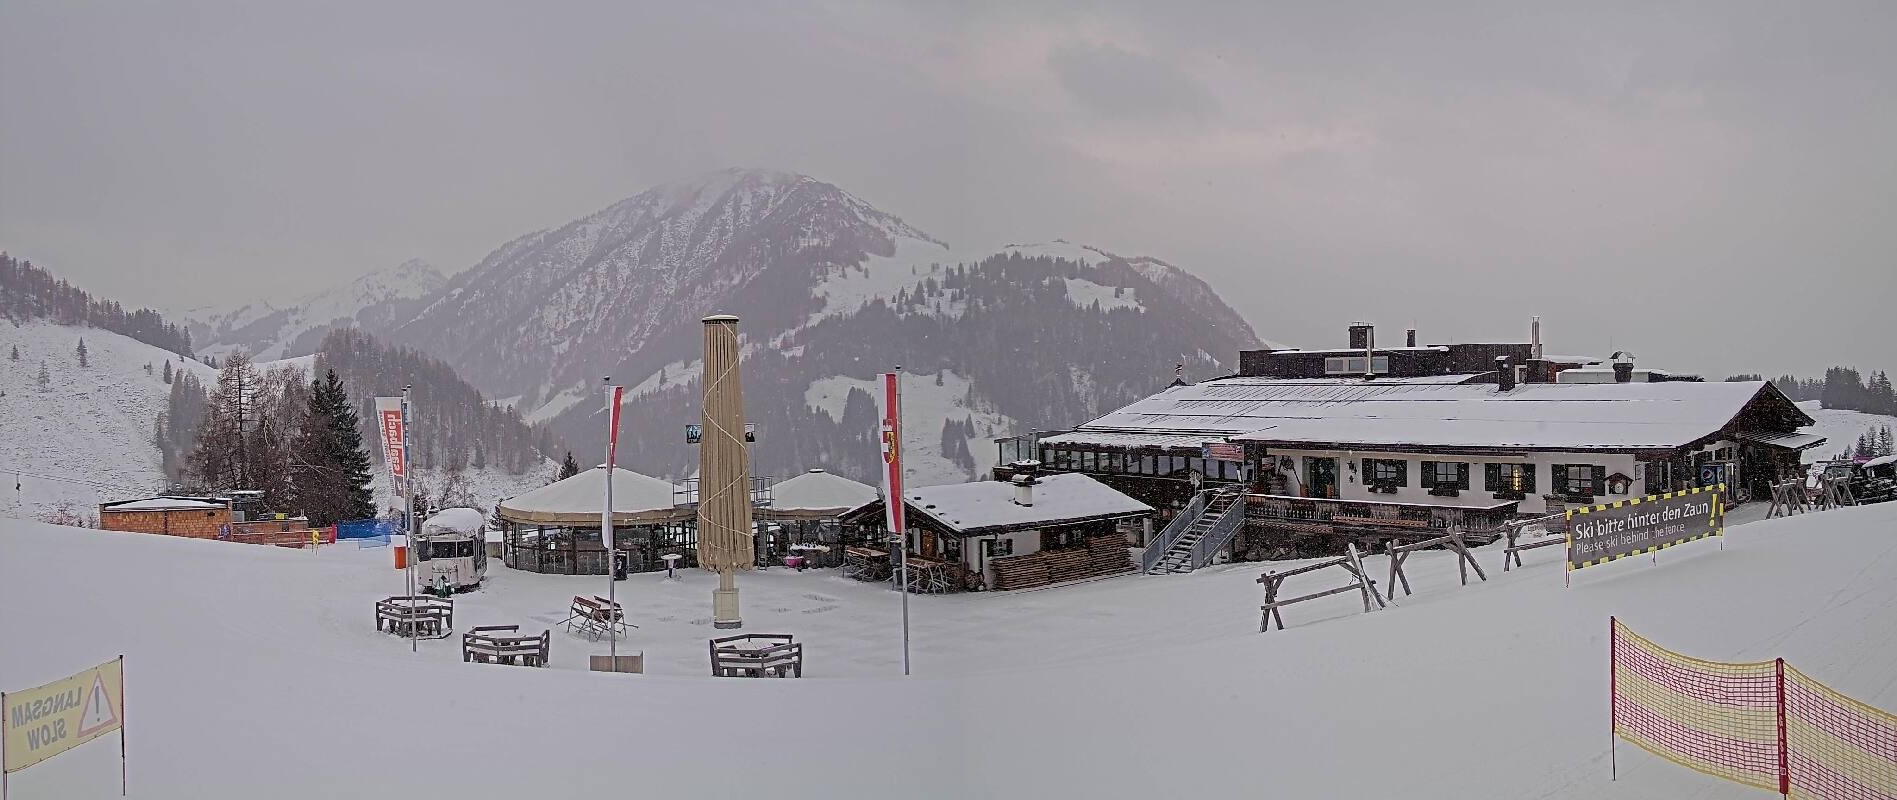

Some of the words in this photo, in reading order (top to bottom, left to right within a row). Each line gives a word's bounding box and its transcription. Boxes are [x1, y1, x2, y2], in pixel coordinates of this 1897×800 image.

[1575, 521, 1594, 541] Ski
[1597, 518, 1624, 536] bitte
[1627, 512, 1660, 530] hinter
[1662, 505, 1681, 522] den
[1683, 502, 1709, 518] Zaun
[1576, 541, 1604, 556] Please
[1606, 535, 1618, 550] ski
[1620, 530, 1649, 546] behind
